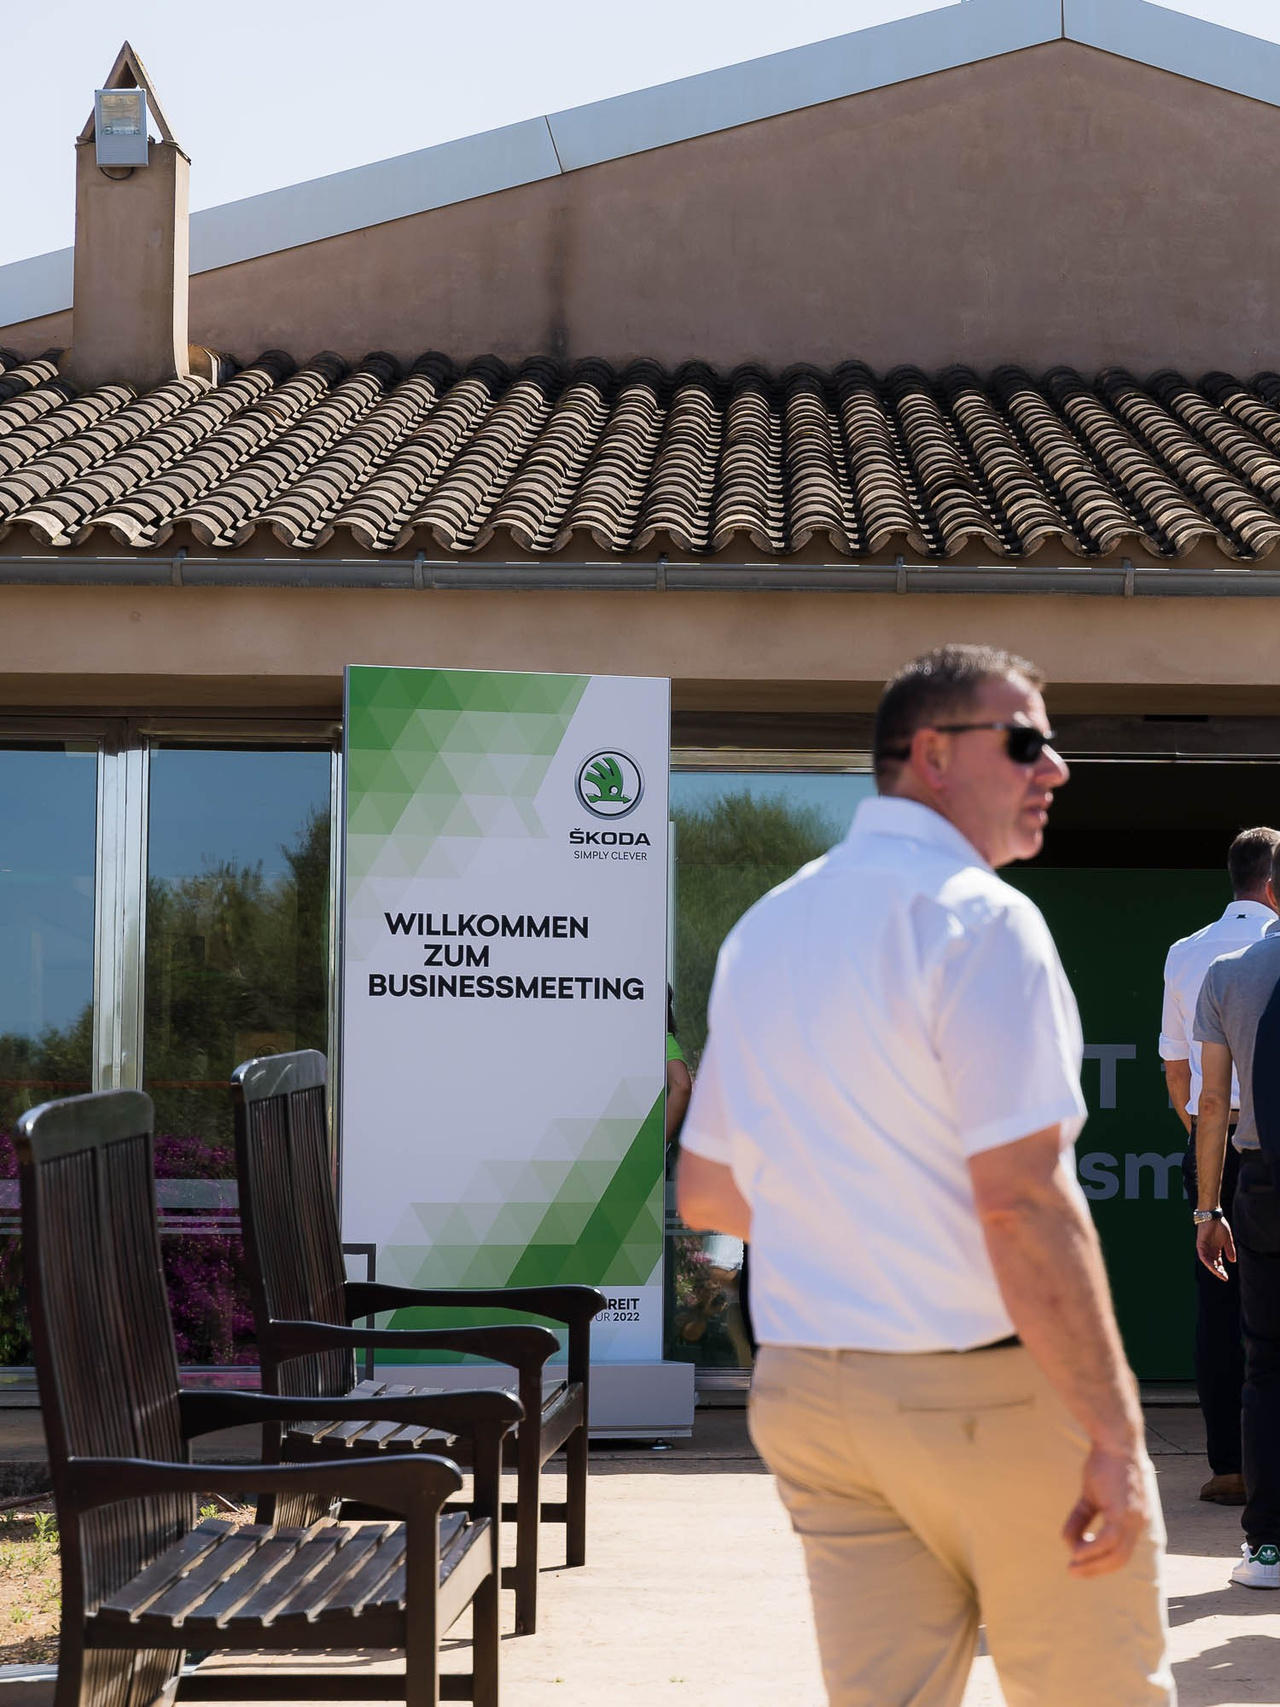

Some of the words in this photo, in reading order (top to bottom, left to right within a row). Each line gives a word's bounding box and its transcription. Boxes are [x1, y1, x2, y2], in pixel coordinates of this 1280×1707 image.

[569, 828, 651, 846] ŠKODA
[574, 850, 609, 860] SIMPLY
[611, 851, 648, 861] CLEVER
[384, 912, 589, 939] WILLKOMMEN
[424, 944, 490, 968] ZUM
[368, 973, 645, 1001] BUSINESSMEETING
[613, 1312, 640, 1322] 2022
